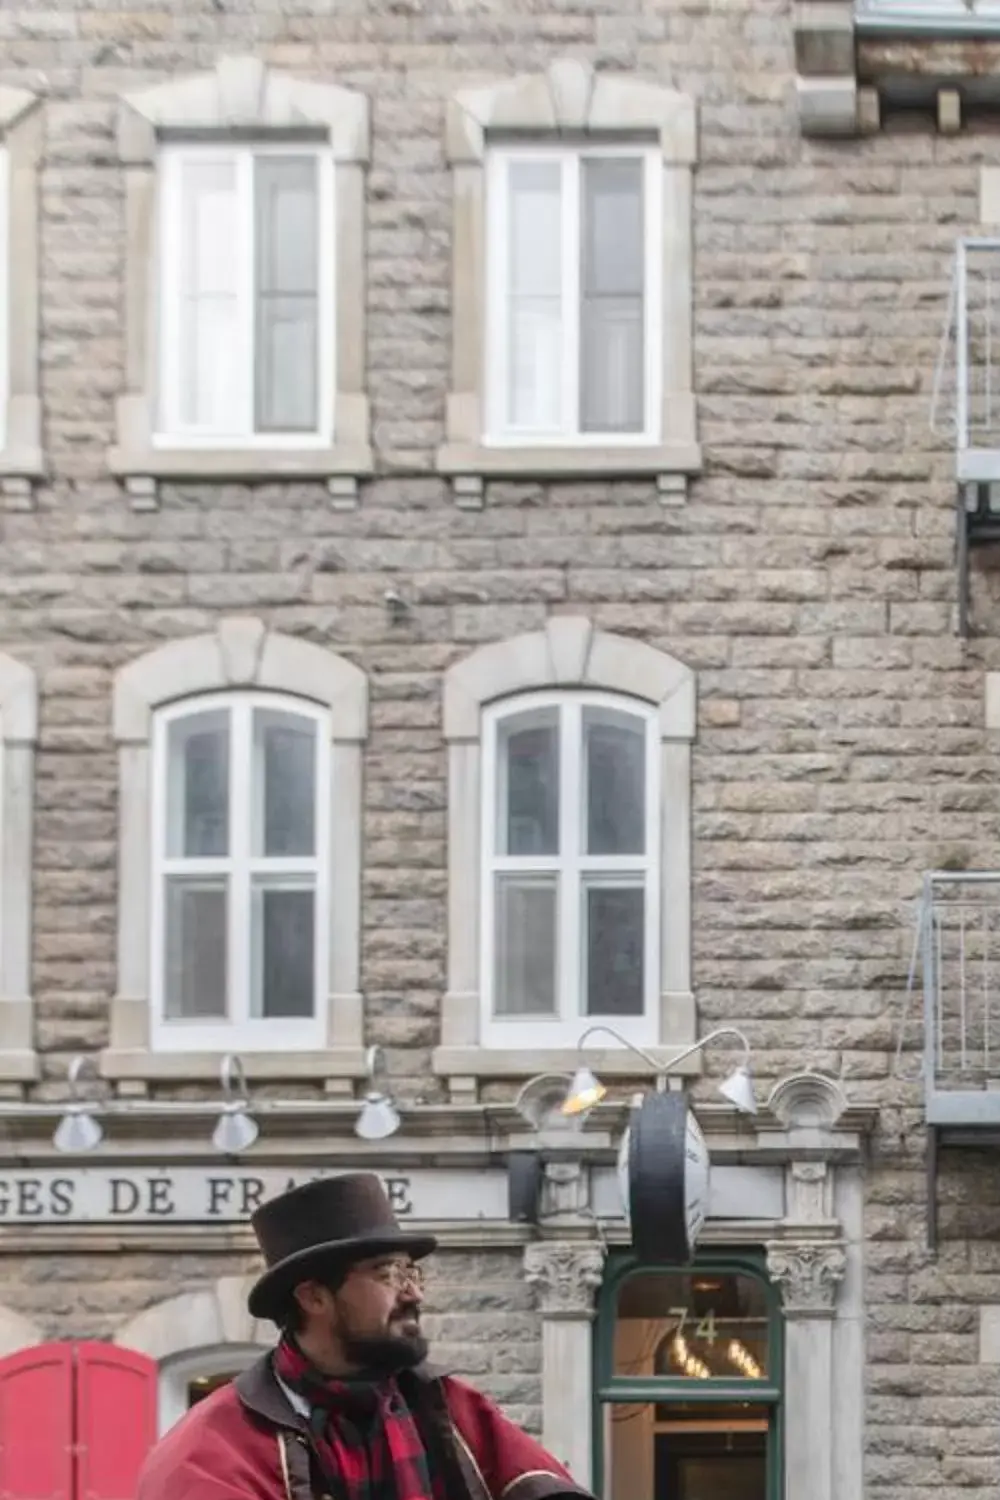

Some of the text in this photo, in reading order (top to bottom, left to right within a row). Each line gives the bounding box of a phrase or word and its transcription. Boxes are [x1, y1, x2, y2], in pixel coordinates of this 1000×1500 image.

[108, 1178, 175, 1215] DE
[206, 1177, 412, 1214] FRE
[668, 1307, 718, 1347] 74
